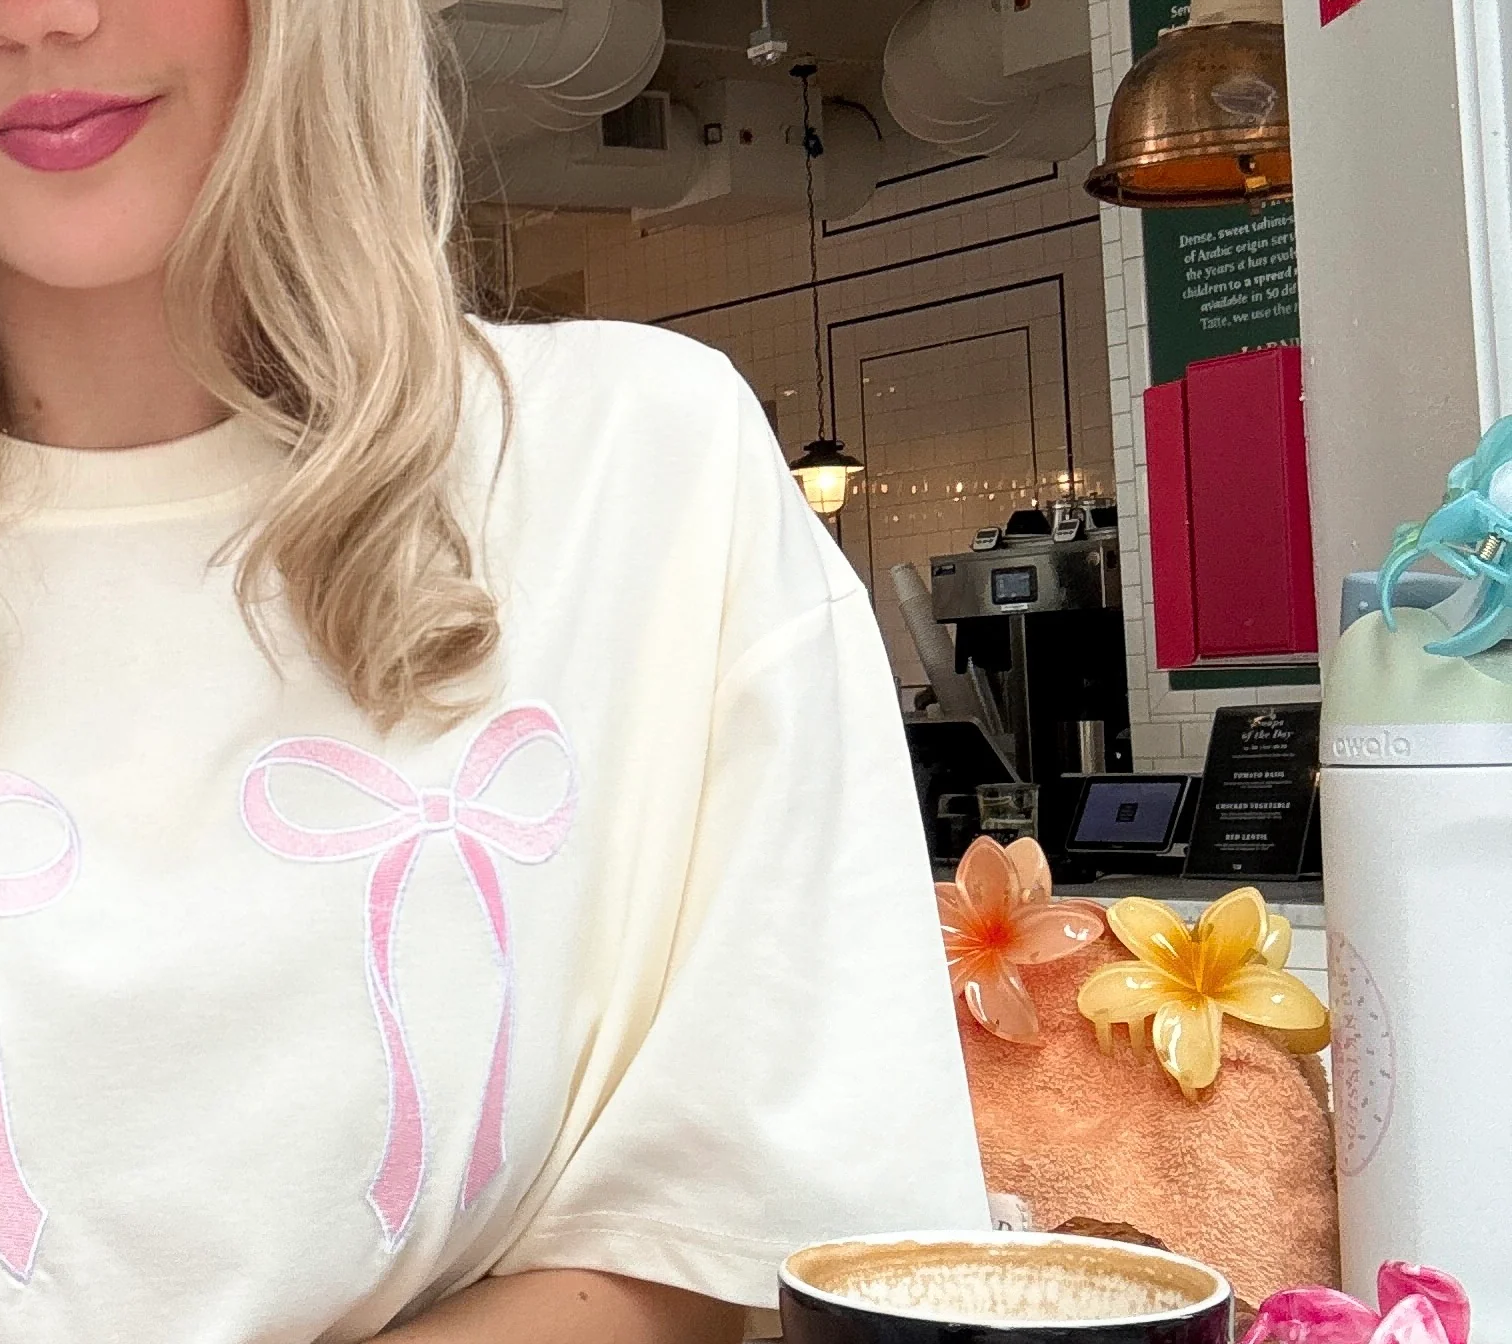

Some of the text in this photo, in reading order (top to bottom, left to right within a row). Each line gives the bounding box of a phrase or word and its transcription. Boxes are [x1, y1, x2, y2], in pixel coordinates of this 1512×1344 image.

[1217, 224, 1250, 240] sweet
[1184, 249, 1197, 264] of
[1198, 244, 1234, 263] Arabic
[1235, 239, 1269, 254] origin
[1185, 267, 1203, 281] the
[1203, 261, 1236, 281] years
[1247, 255, 1268, 268] has
[1182, 282, 1228, 300] children
[1228, 280, 1242, 291] to
[1253, 265, 1292, 287] spread
[1200, 293, 1249, 312] available
[1251, 289, 1263, 303] in
[1232, 313, 1249, 323] we
[1251, 308, 1272, 320] use
[1272, 302, 1292, 317] the
[1333, 729, 1411, 758] owala
